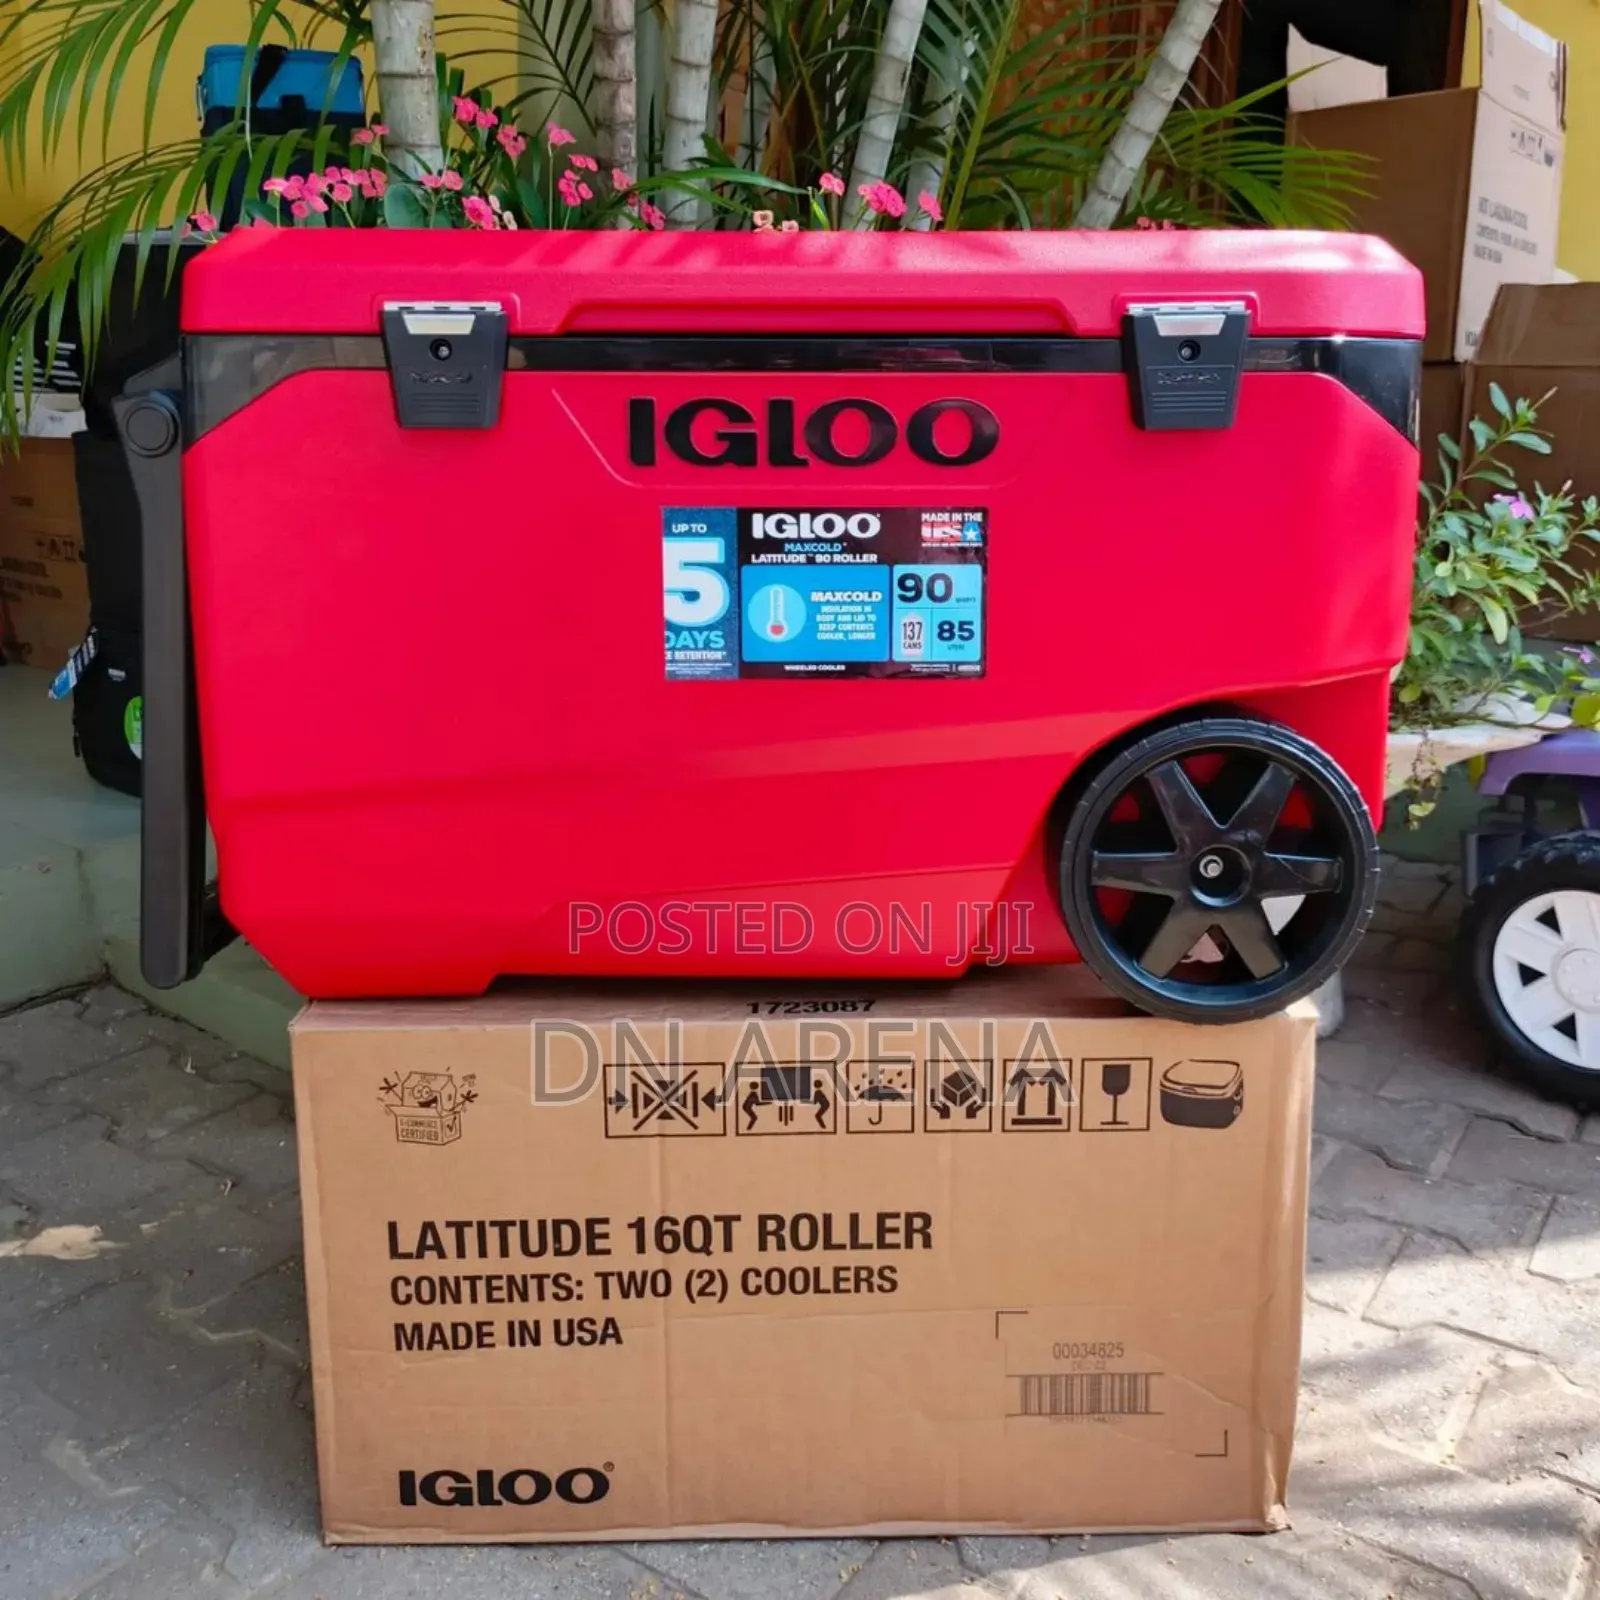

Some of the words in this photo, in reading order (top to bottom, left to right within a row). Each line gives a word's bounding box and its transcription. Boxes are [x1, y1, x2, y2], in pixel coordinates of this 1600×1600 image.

[628, 397, 1001, 467] IGLOO
[921, 512, 951, 522] MADE
[951, 512, 962, 522] IN
[963, 512, 983, 522] THE
[671, 523, 689, 534] UP
[691, 523, 708, 534] TO
[833, 553, 878, 563] ROLLER
[663, 537, 730, 628] 5
[897, 572, 953, 604] 90
[811, 591, 882, 602] MAXCOLD
[867, 614, 877, 622] TO
[664, 630, 726, 649] DAYS
[902, 621, 923, 641] 137
[937, 620, 975, 642] 85
[902, 641, 922, 650] CANS
[746, 1000, 877, 1015] 1723087
[400, 1128, 439, 1141] CERTIFIED
[387, 1217, 612, 1260] LATITUDE
[627, 1214, 742, 1257] 16QT
[757, 1211, 933, 1254] ROLLER
[390, 1272, 584, 1306] CONTENTS:
[595, 1269, 672, 1301] TWO
[684, 1268, 729, 1304] (2)
[740, 1265, 899, 1297] COOLERS
[393, 1320, 496, 1352] MADE
[506, 1319, 542, 1349] IN
[552, 1316, 624, 1347] USA
[1052, 1342, 1125, 1360] 00034825
